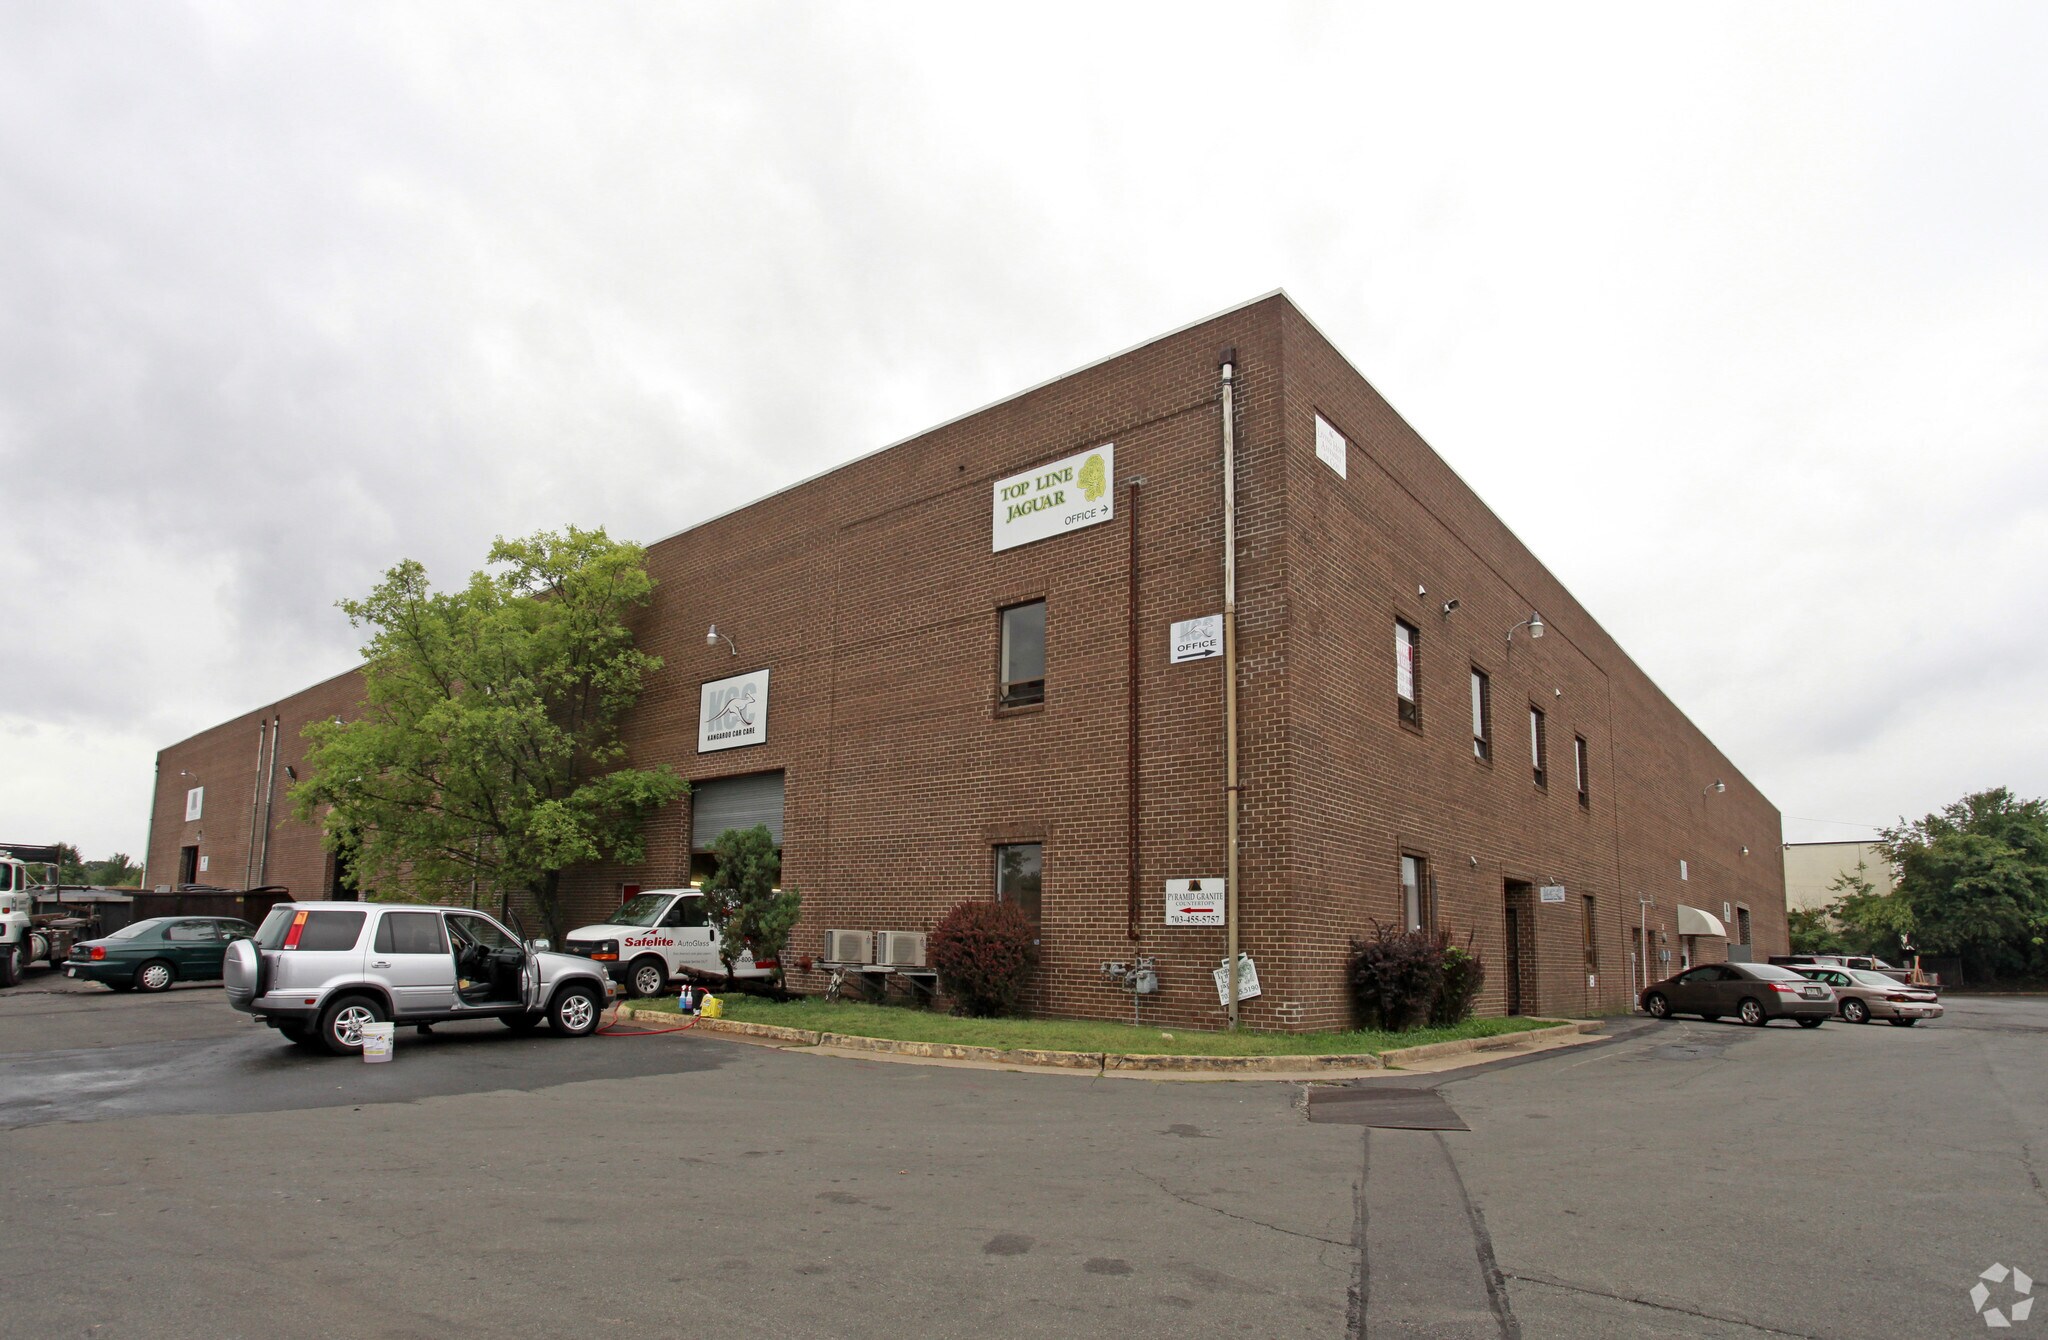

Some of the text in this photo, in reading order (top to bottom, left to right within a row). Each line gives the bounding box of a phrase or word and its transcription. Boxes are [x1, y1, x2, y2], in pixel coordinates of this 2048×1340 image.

[1000, 466, 1074, 502] TOP LINE
[1006, 490, 1066, 524] JAGUAR
[1064, 508, 1097, 526] OFFICE
[1177, 639, 1217, 652] OFFICE
[707, 682, 757, 733] KCC
[707, 727, 755, 741] KANGAROO CAR CARE
[1167, 892, 1224, 901] PYRAMID GRANITE
[1170, 915, 1220, 924] 703-455-5757
[624, 937, 710, 947] Safelite AutoGlass
